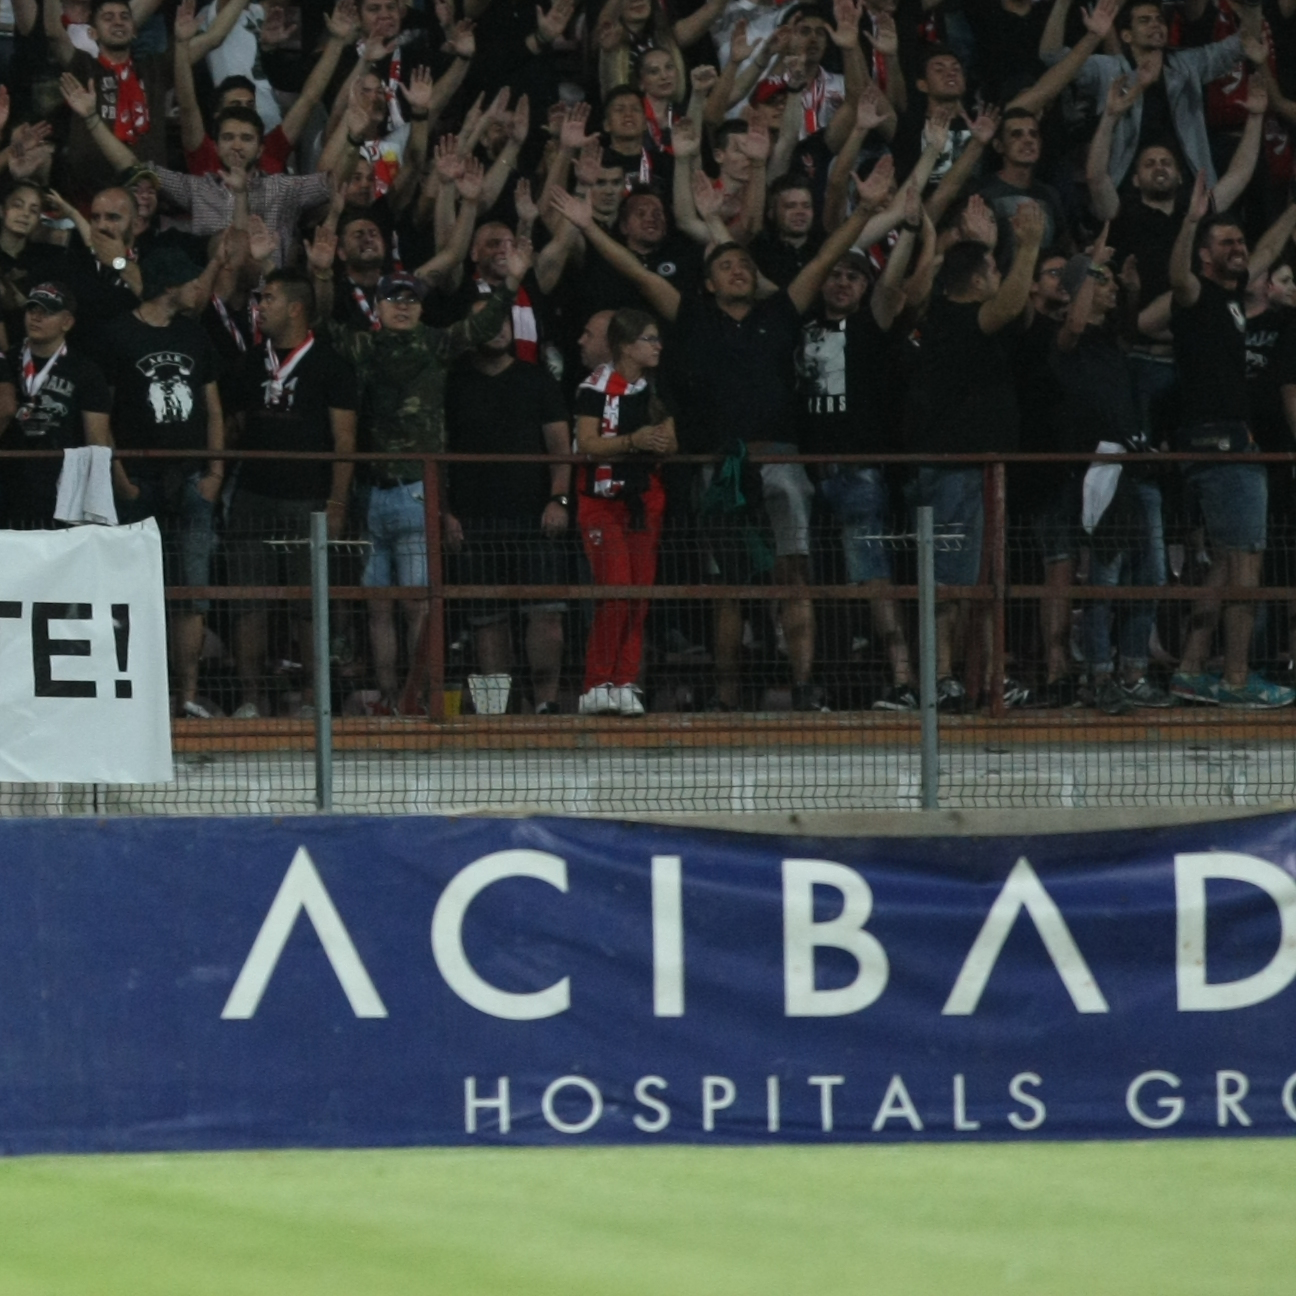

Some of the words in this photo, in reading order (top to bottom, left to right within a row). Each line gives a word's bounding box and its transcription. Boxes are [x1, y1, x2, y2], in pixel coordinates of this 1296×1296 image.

[220, 845, 1296, 1021] ACIBAD
[464, 1071, 1048, 1135] HOSPITALS
[1125, 1069, 1296, 1129] GR
